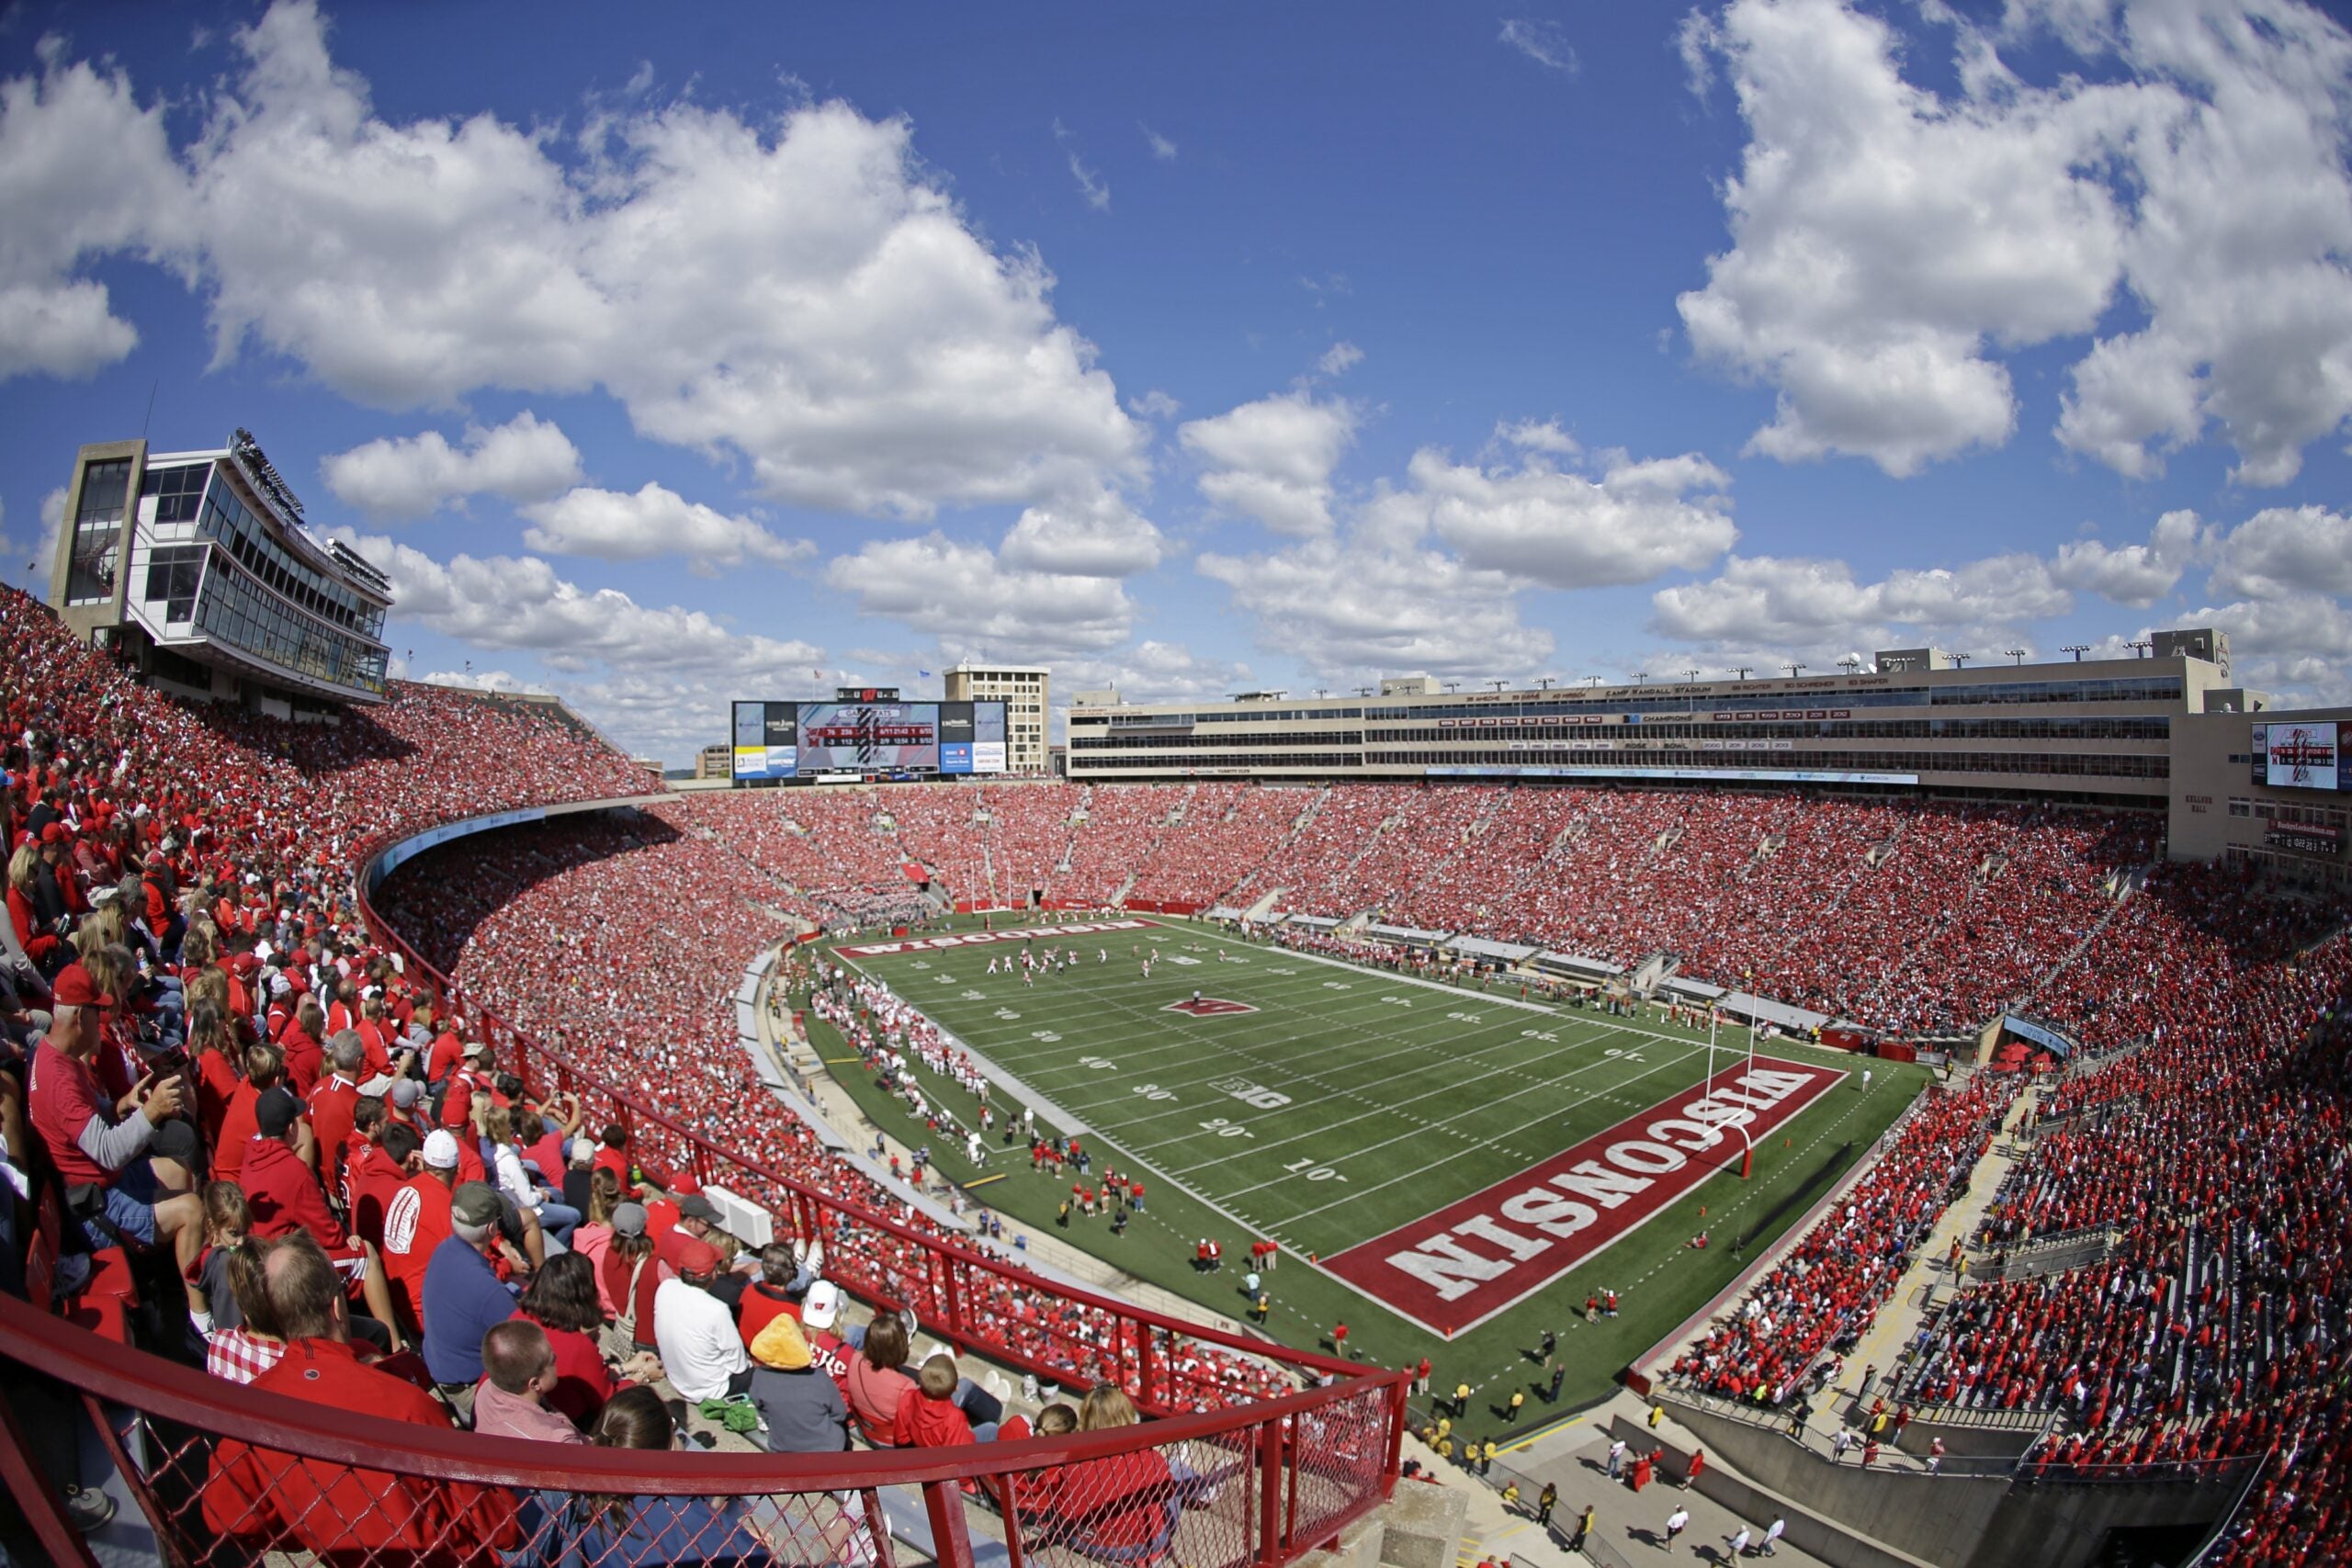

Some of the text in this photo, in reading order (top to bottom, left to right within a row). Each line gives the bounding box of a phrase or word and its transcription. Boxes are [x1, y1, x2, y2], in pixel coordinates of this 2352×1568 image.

[2185, 795, 2212, 805] KELLNER
[2191, 805, 2207, 813] HALL
[2278, 821, 2336, 836] BuckysLockerRoom.com
[851, 920, 1147, 955] WISCONSIN
[1031, 1030, 1063, 1043] 50
[1078, 1056, 1113, 1069] 40
[1133, 1084, 1172, 1100] 30
[1199, 1118, 1246, 1137] 20
[1283, 1157, 1337, 1181] 10
[1385, 1068, 1816, 1302] WISCONSIN
